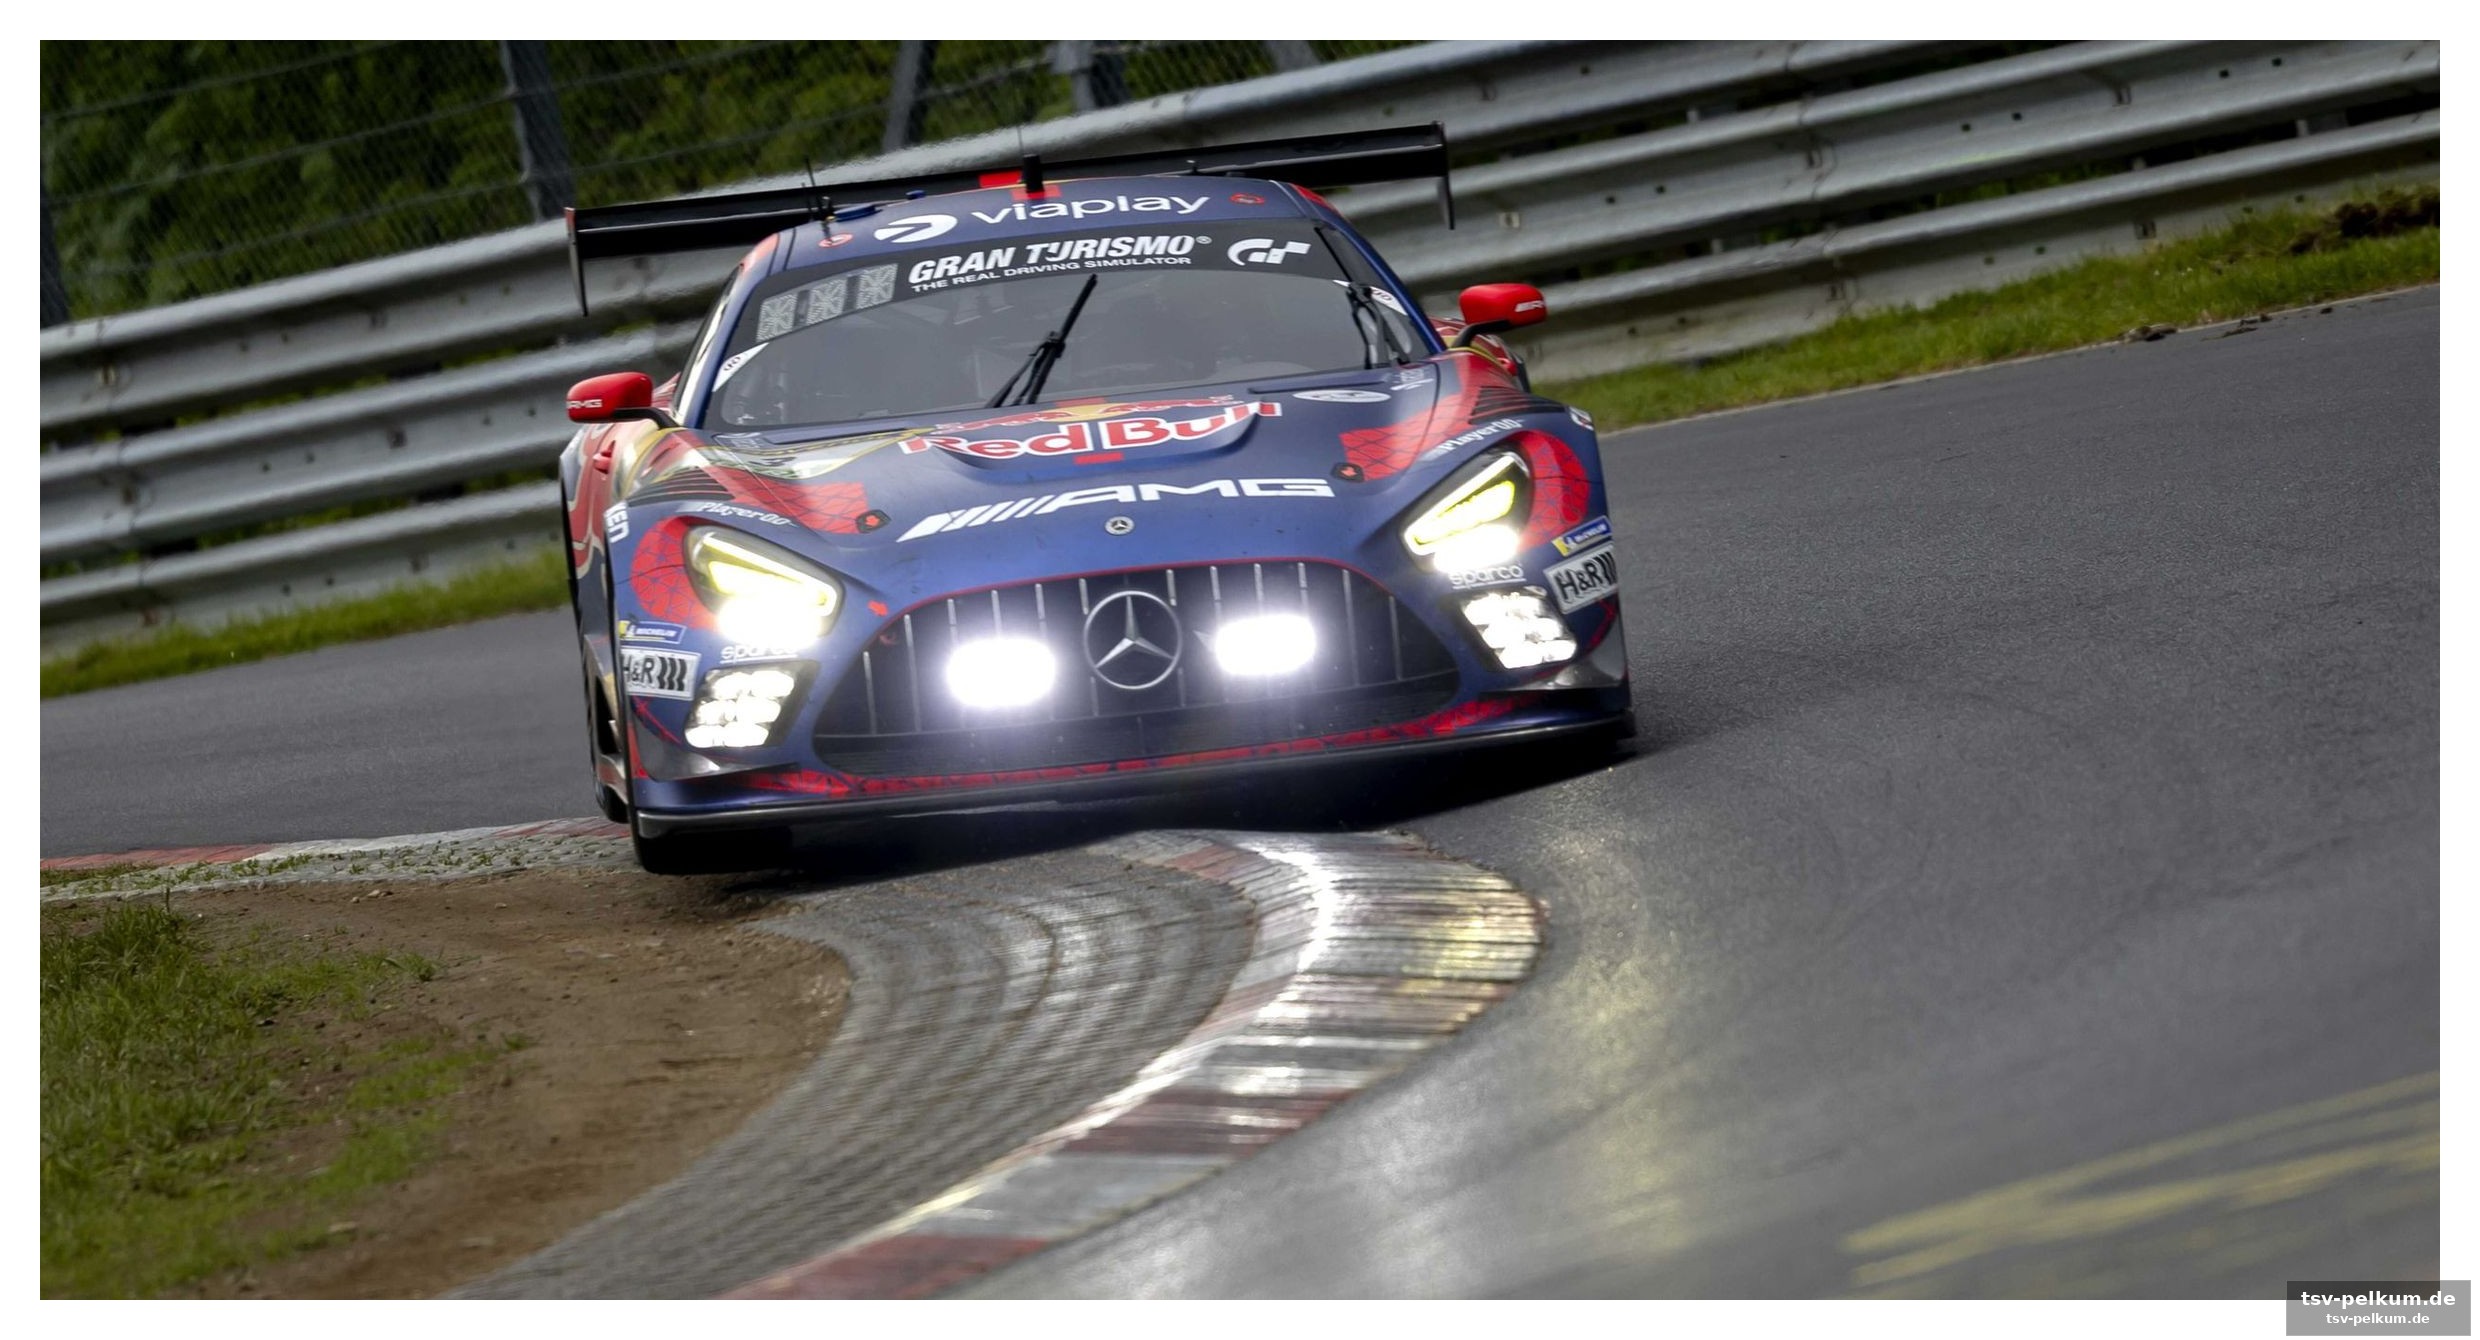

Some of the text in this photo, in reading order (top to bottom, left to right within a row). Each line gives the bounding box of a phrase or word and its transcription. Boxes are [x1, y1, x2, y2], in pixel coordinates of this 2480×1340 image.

[971, 194, 1211, 225] viaplay
[907, 243, 1010, 285] GRAN
[912, 256, 1192, 294] THE REAL DRIVING SIMULATOR
[900, 401, 1282, 459] Red Bull
[1037, 478, 1336, 514] AMG
[1449, 565, 1525, 589] sparco
